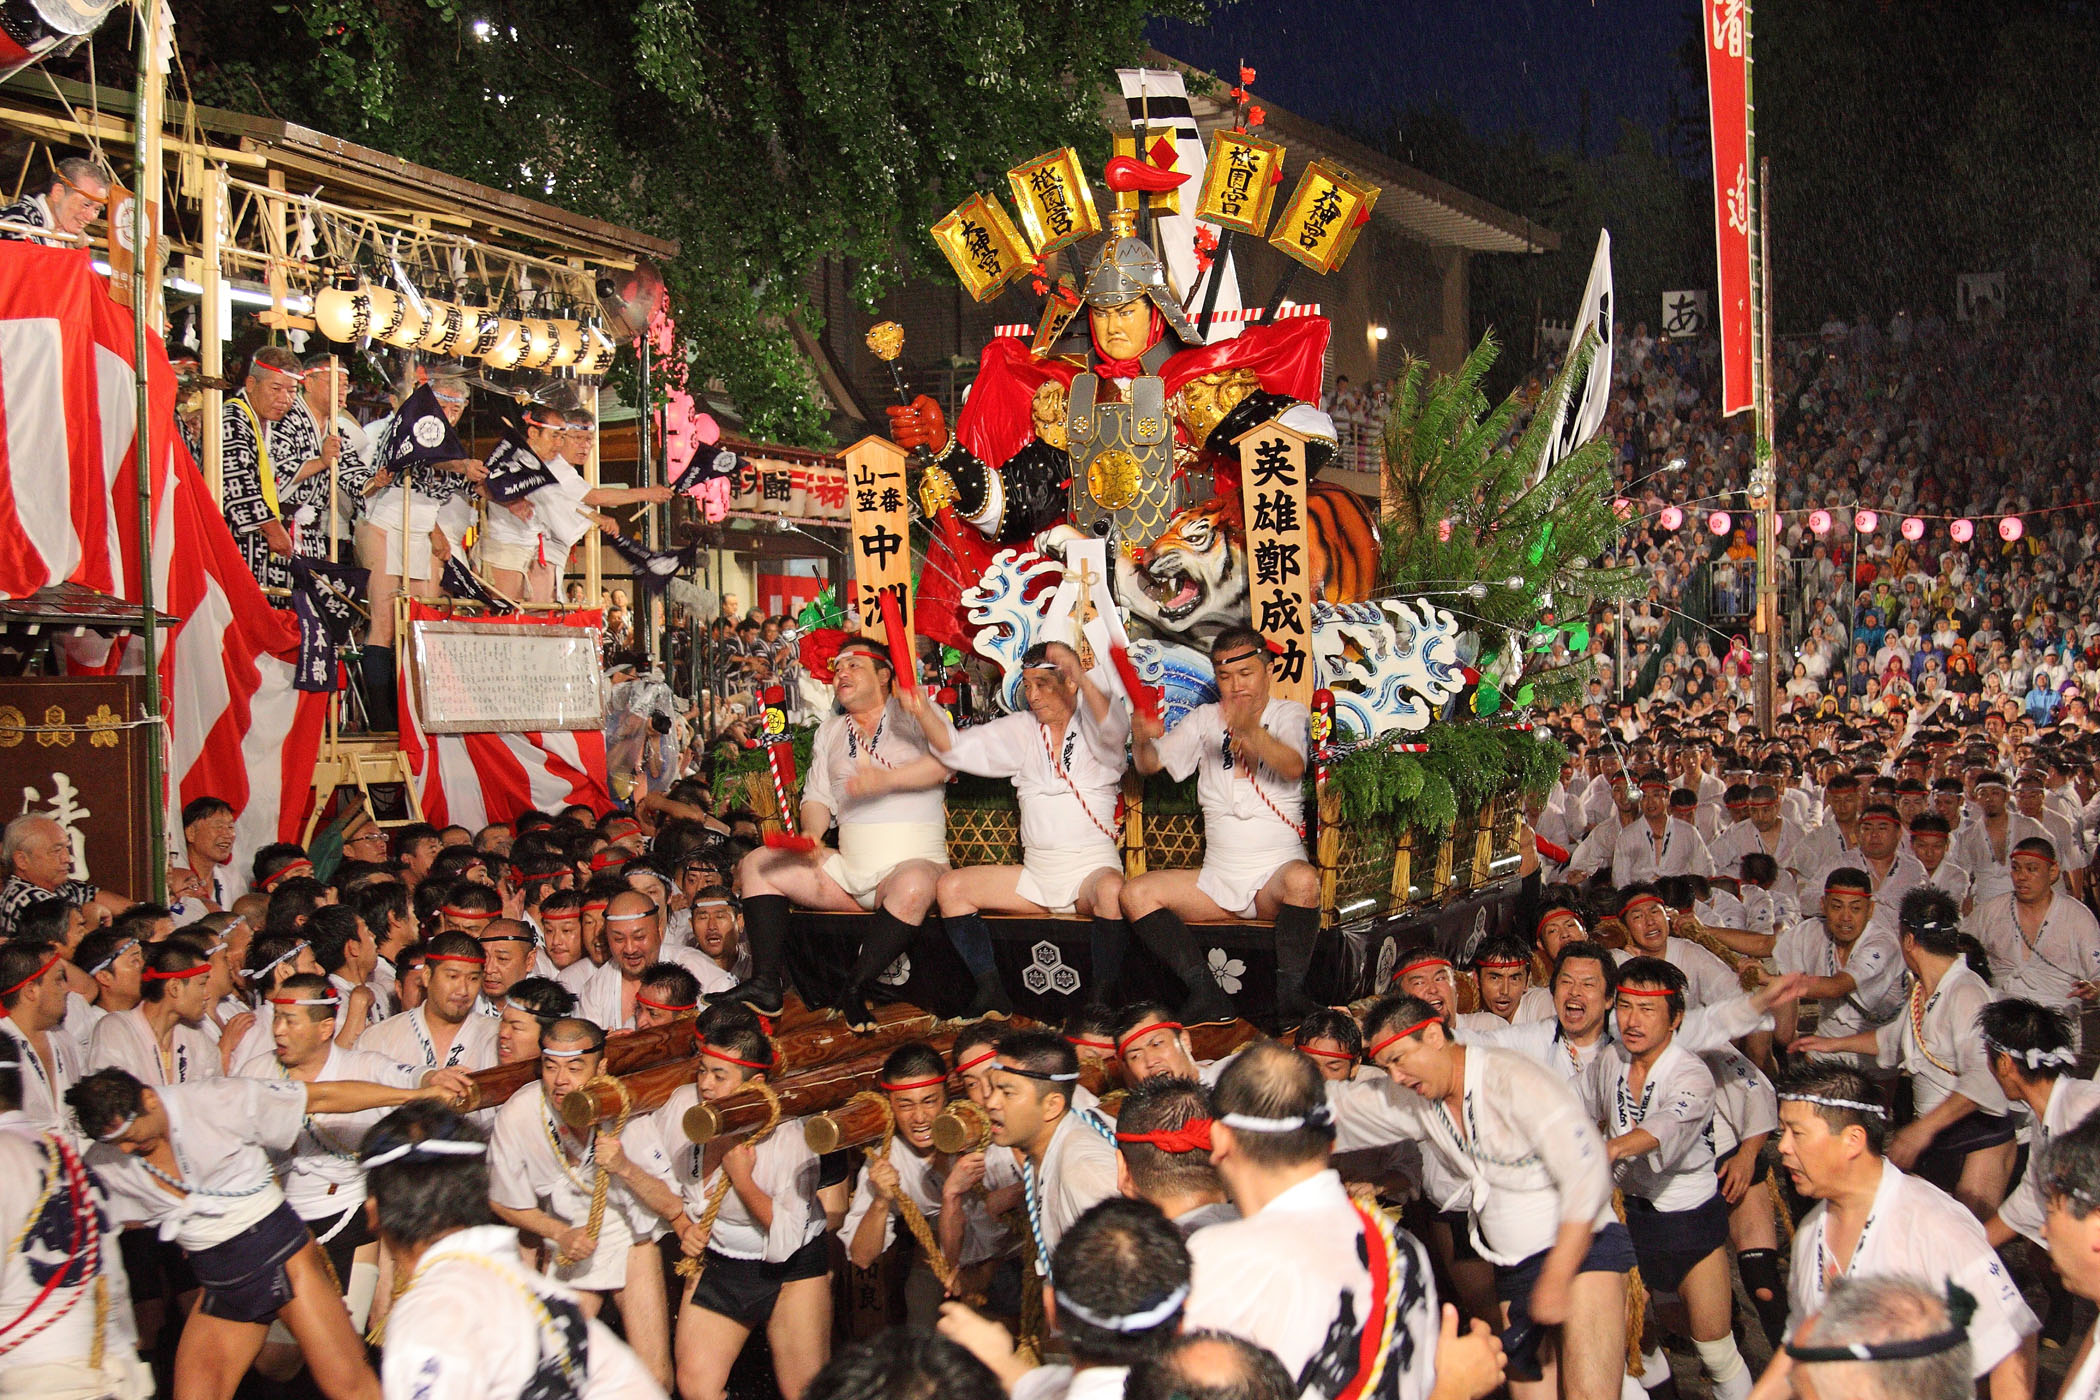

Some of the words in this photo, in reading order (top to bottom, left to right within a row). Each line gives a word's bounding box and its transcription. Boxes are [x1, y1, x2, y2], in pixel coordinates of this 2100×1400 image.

[1298, 184, 1342, 251] 大神宮
[960, 219, 1003, 278] 大神宮
[1667, 293, 1706, 334] あ
[853, 464, 878, 513] 山笠
[877, 471, 904, 513] 一番
[859, 524, 908, 628] 中洲
[1251, 438, 1307, 684] 英雄鄭成功
